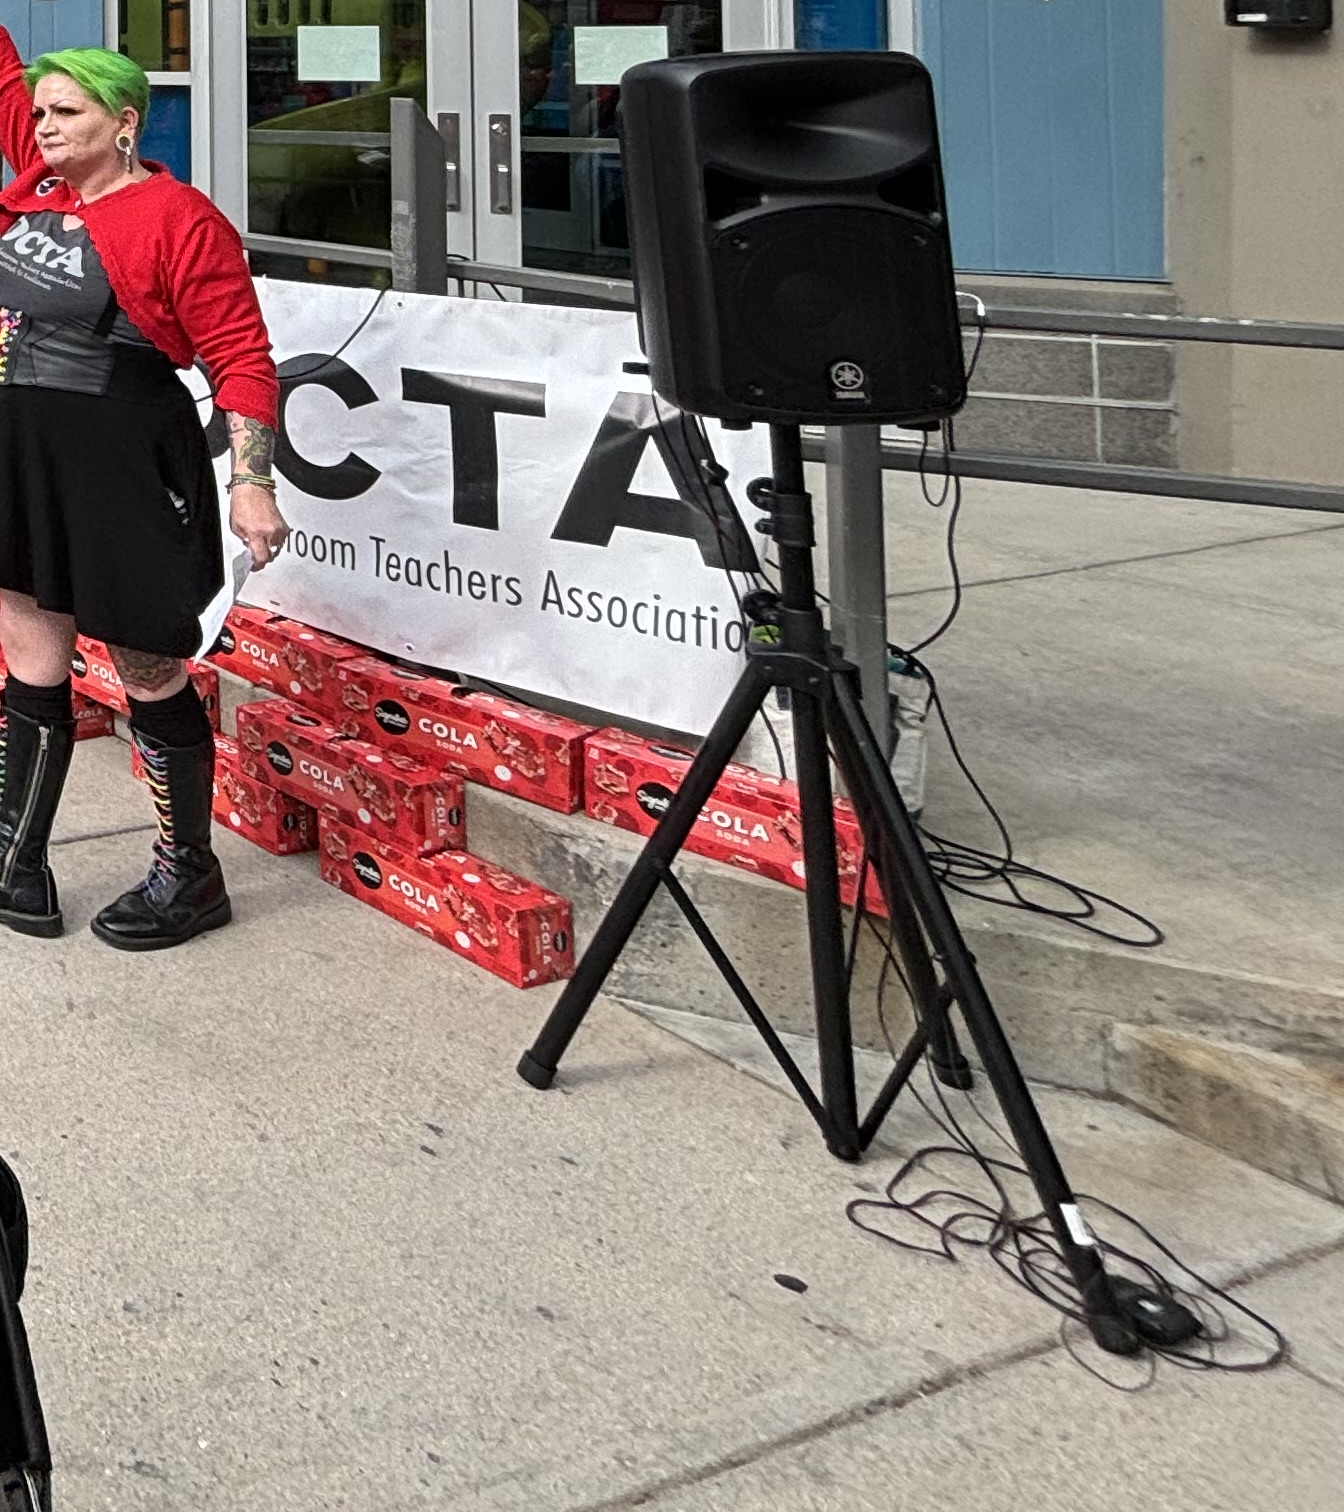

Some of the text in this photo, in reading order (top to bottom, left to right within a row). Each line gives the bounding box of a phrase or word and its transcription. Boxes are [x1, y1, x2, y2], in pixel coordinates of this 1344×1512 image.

[204, 352, 762, 574] CTA
[283, 522, 750, 654] room Teachers Associatio
[240, 640, 280, 667] COLA
[77, 708, 104, 719] COLA
[418, 718, 478, 750] COLA
[435, 739, 464, 755] SODA
[299, 759, 345, 792] COLA
[434, 796, 447, 838] COLA
[388, 873, 440, 913] COLA
[403, 896, 428, 916] SODA
[541, 921, 552, 965] COLA
